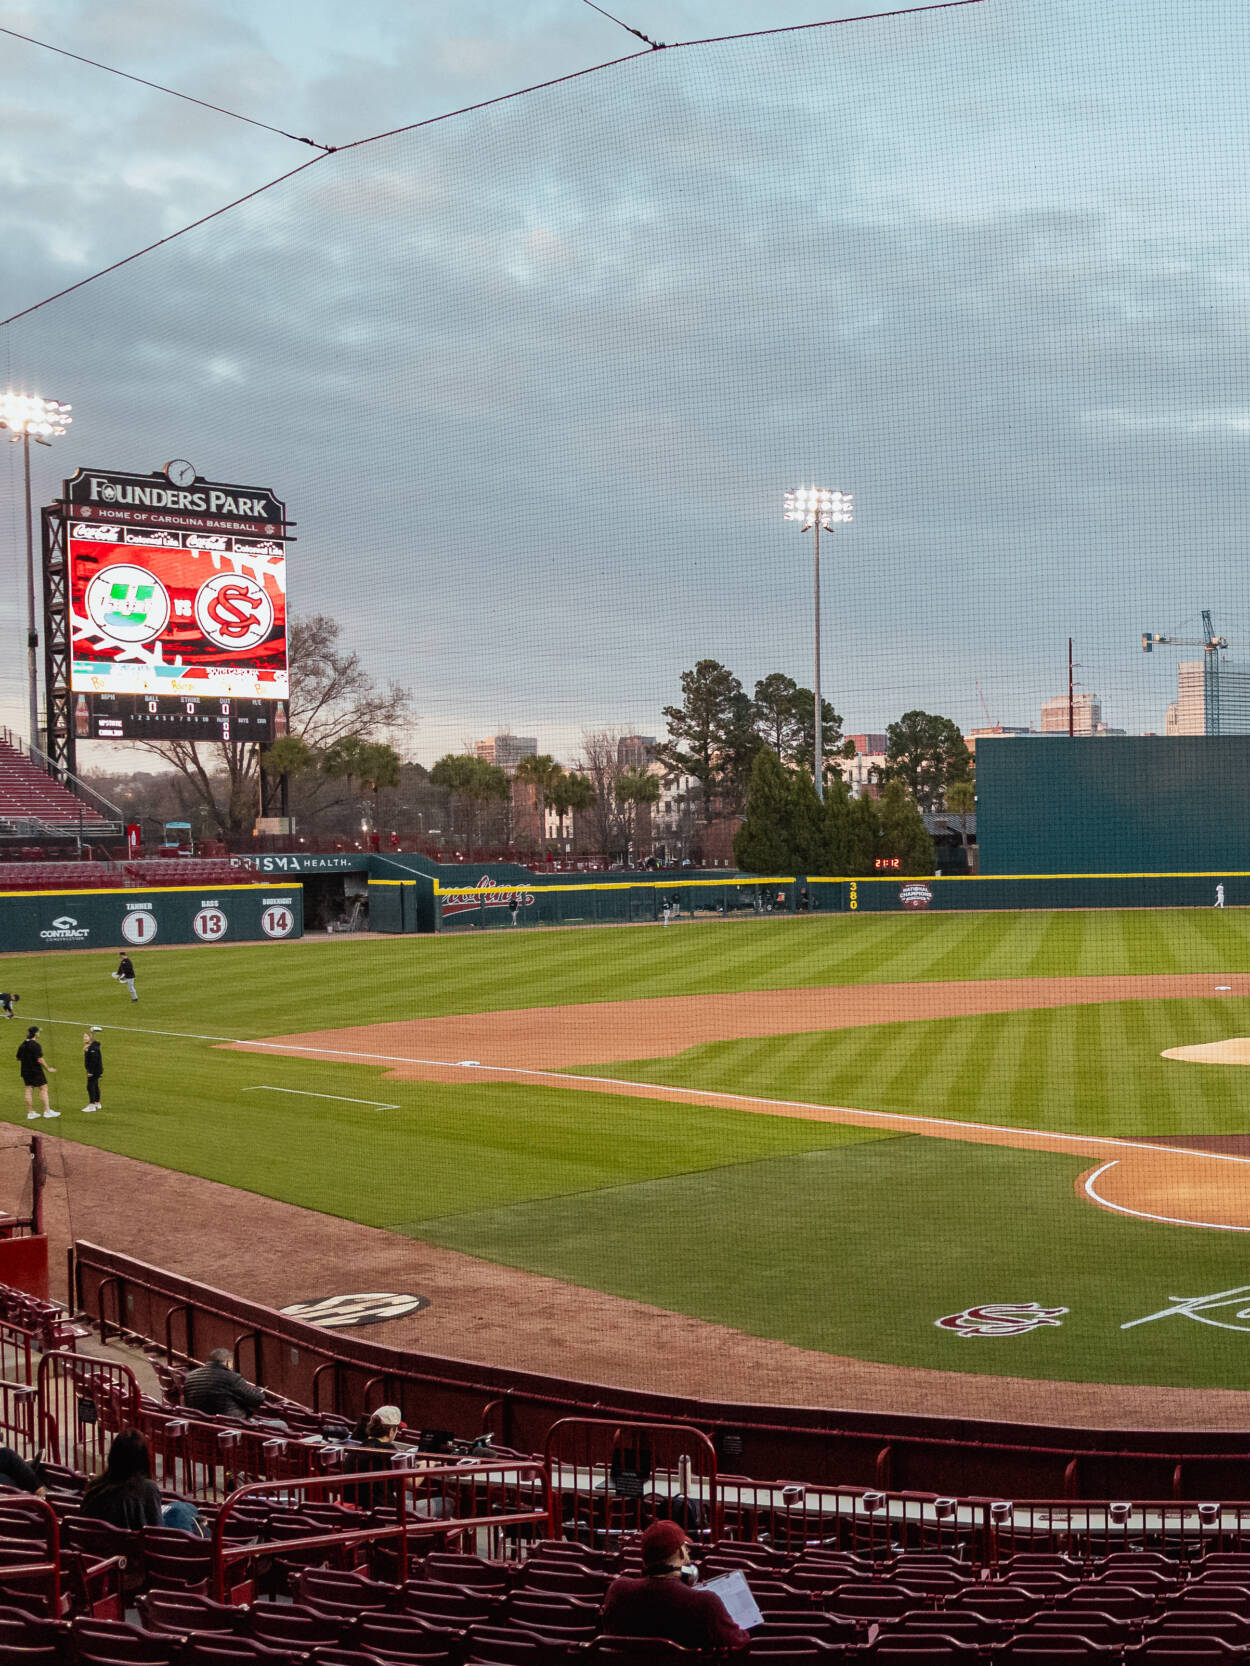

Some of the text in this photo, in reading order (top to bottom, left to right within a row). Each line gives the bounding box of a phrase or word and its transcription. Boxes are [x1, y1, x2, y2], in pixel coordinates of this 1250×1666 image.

[90, 478, 268, 518] FOUNDERS PARK
[98, 510, 130, 519] HOME
[150, 514, 204, 526] CAROLINA
[206, 520, 258, 532] BASEBALL
[149, 702, 157, 713] 0
[186, 702, 194, 714] 0
[222, 704, 230, 715] 0
[223, 731, 230, 740] 0
[874, 859, 900, 868] 21:12
[135, 918, 144, 937] 1
[200, 914, 221, 934] 13
[268, 912, 288, 931] 14
[40, 929, 89, 938] CONTRACT
